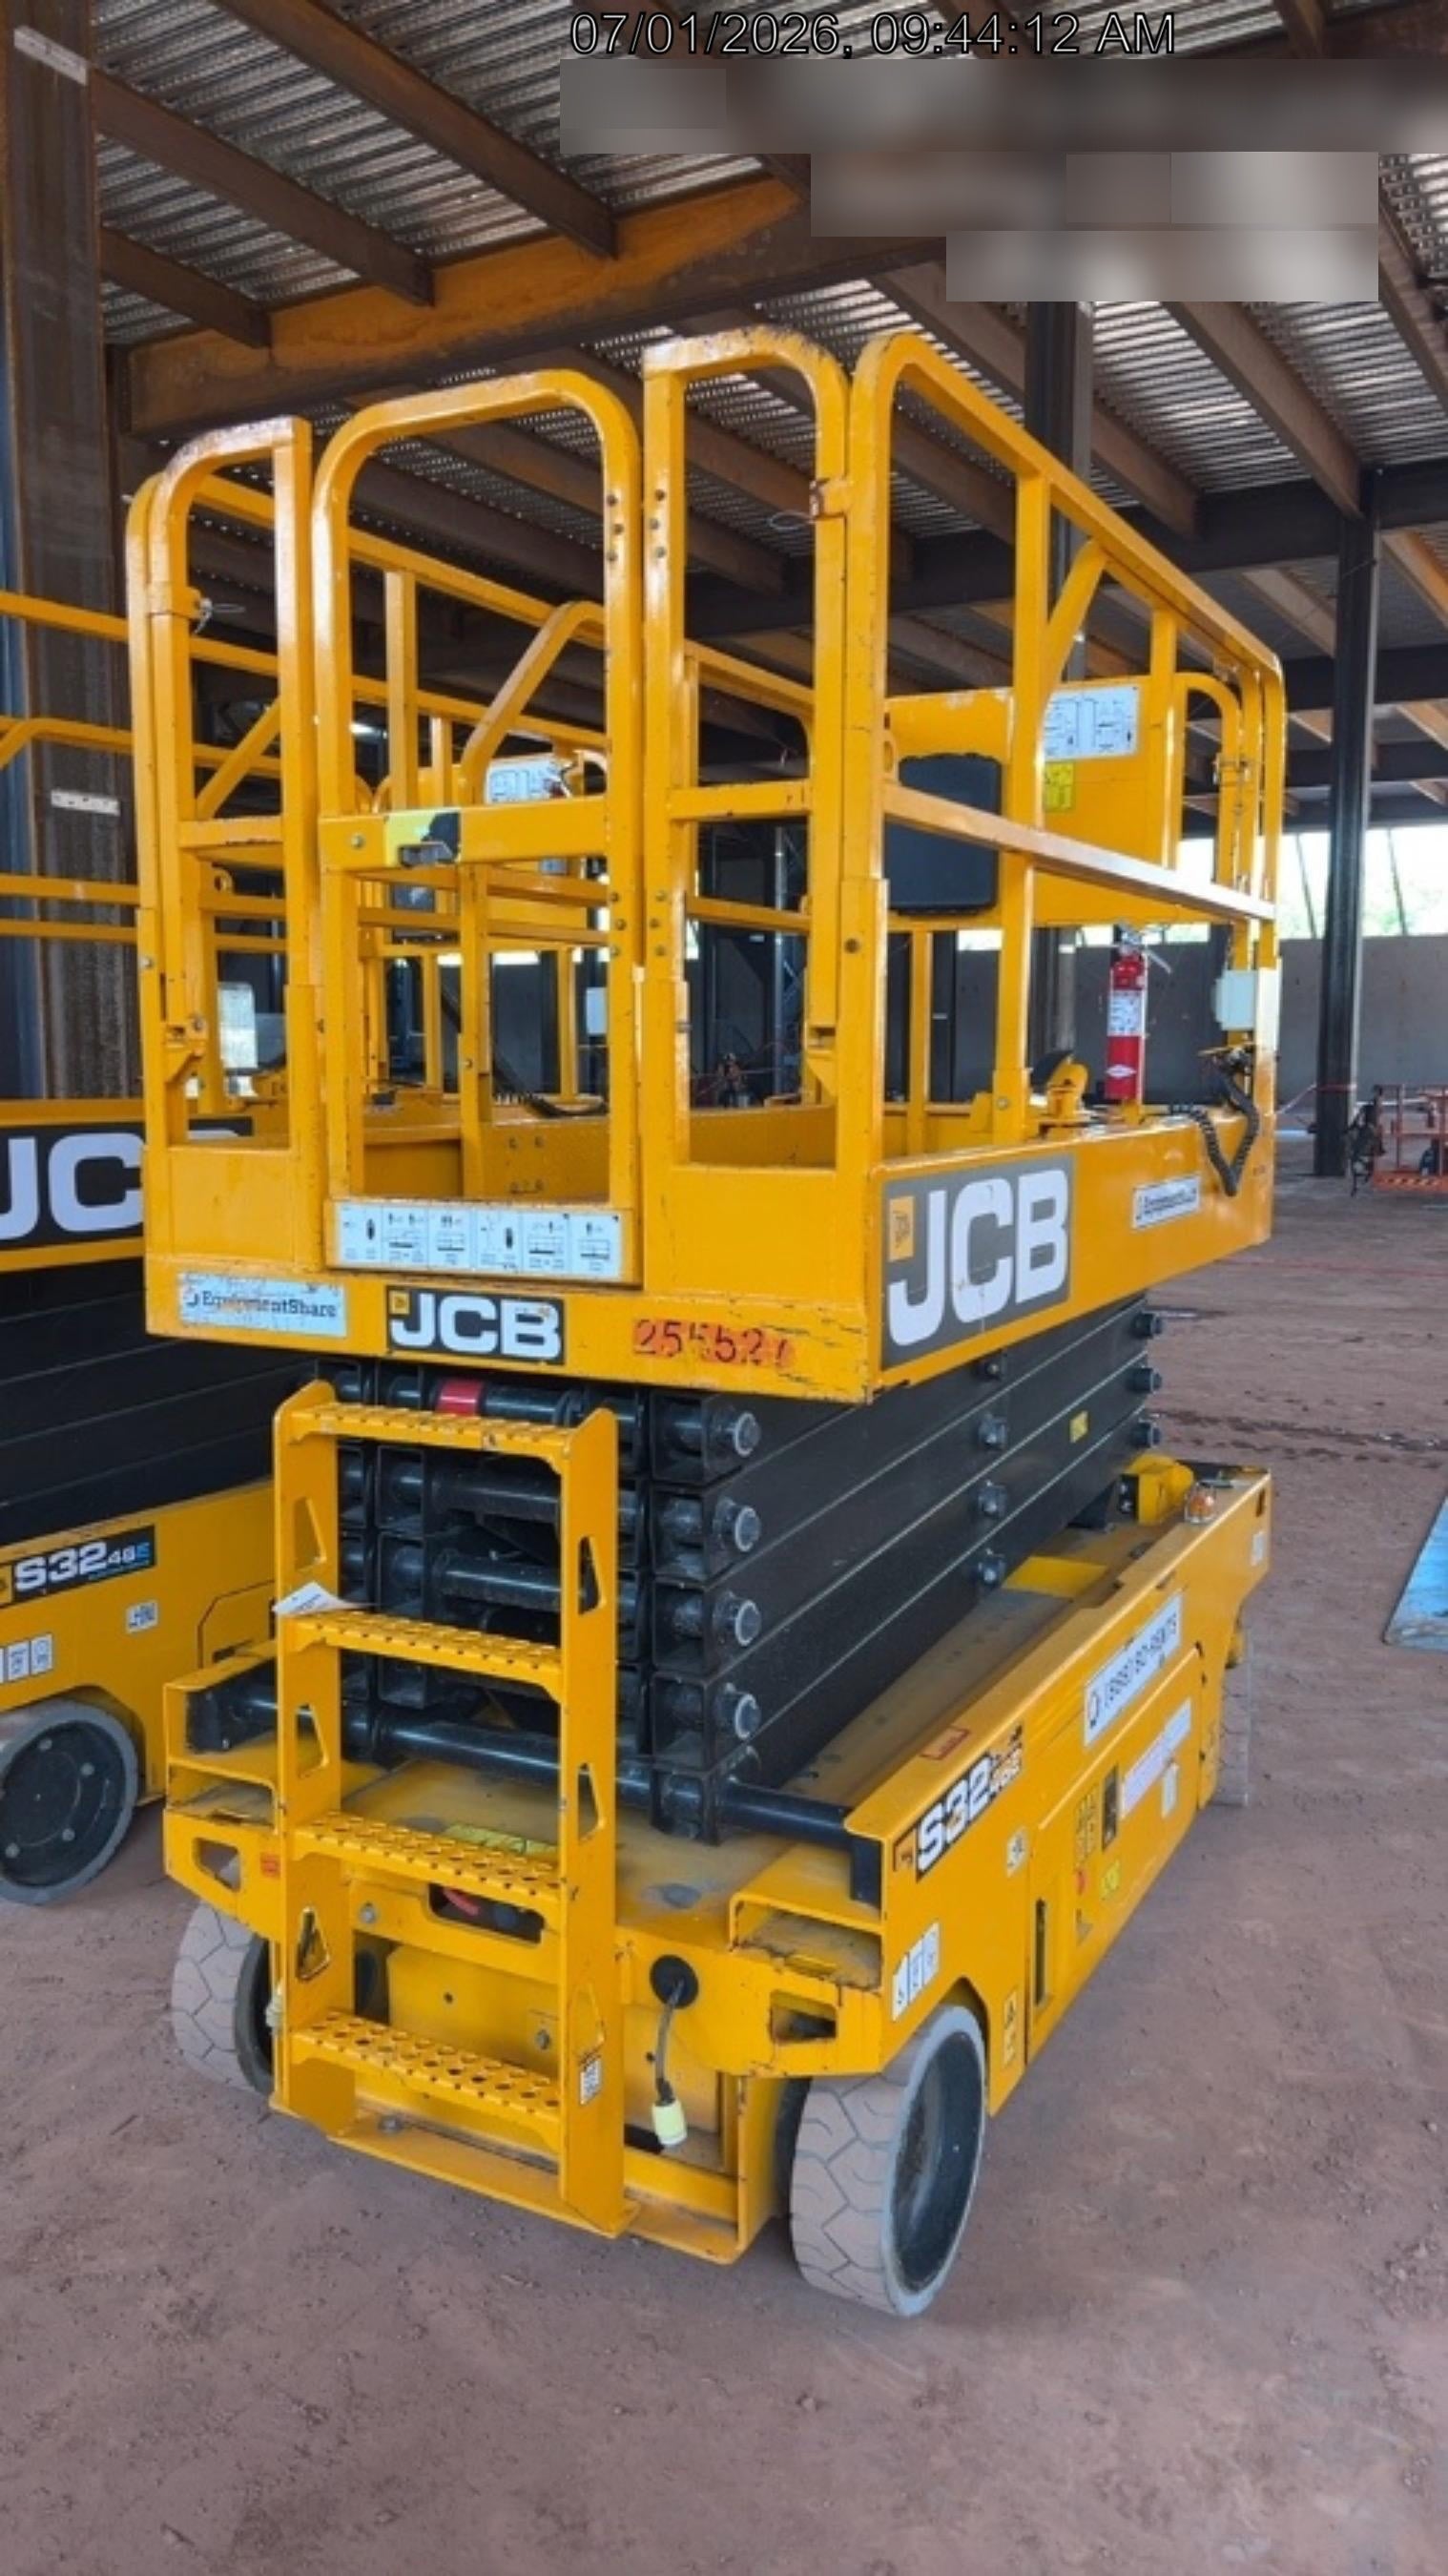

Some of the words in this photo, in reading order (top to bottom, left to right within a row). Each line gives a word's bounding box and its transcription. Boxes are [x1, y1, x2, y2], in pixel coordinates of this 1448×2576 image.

[0, 1132, 144, 1240] JC
[888, 1170, 1068, 1346] JCB
[391, 1292, 562, 1360] JCB
